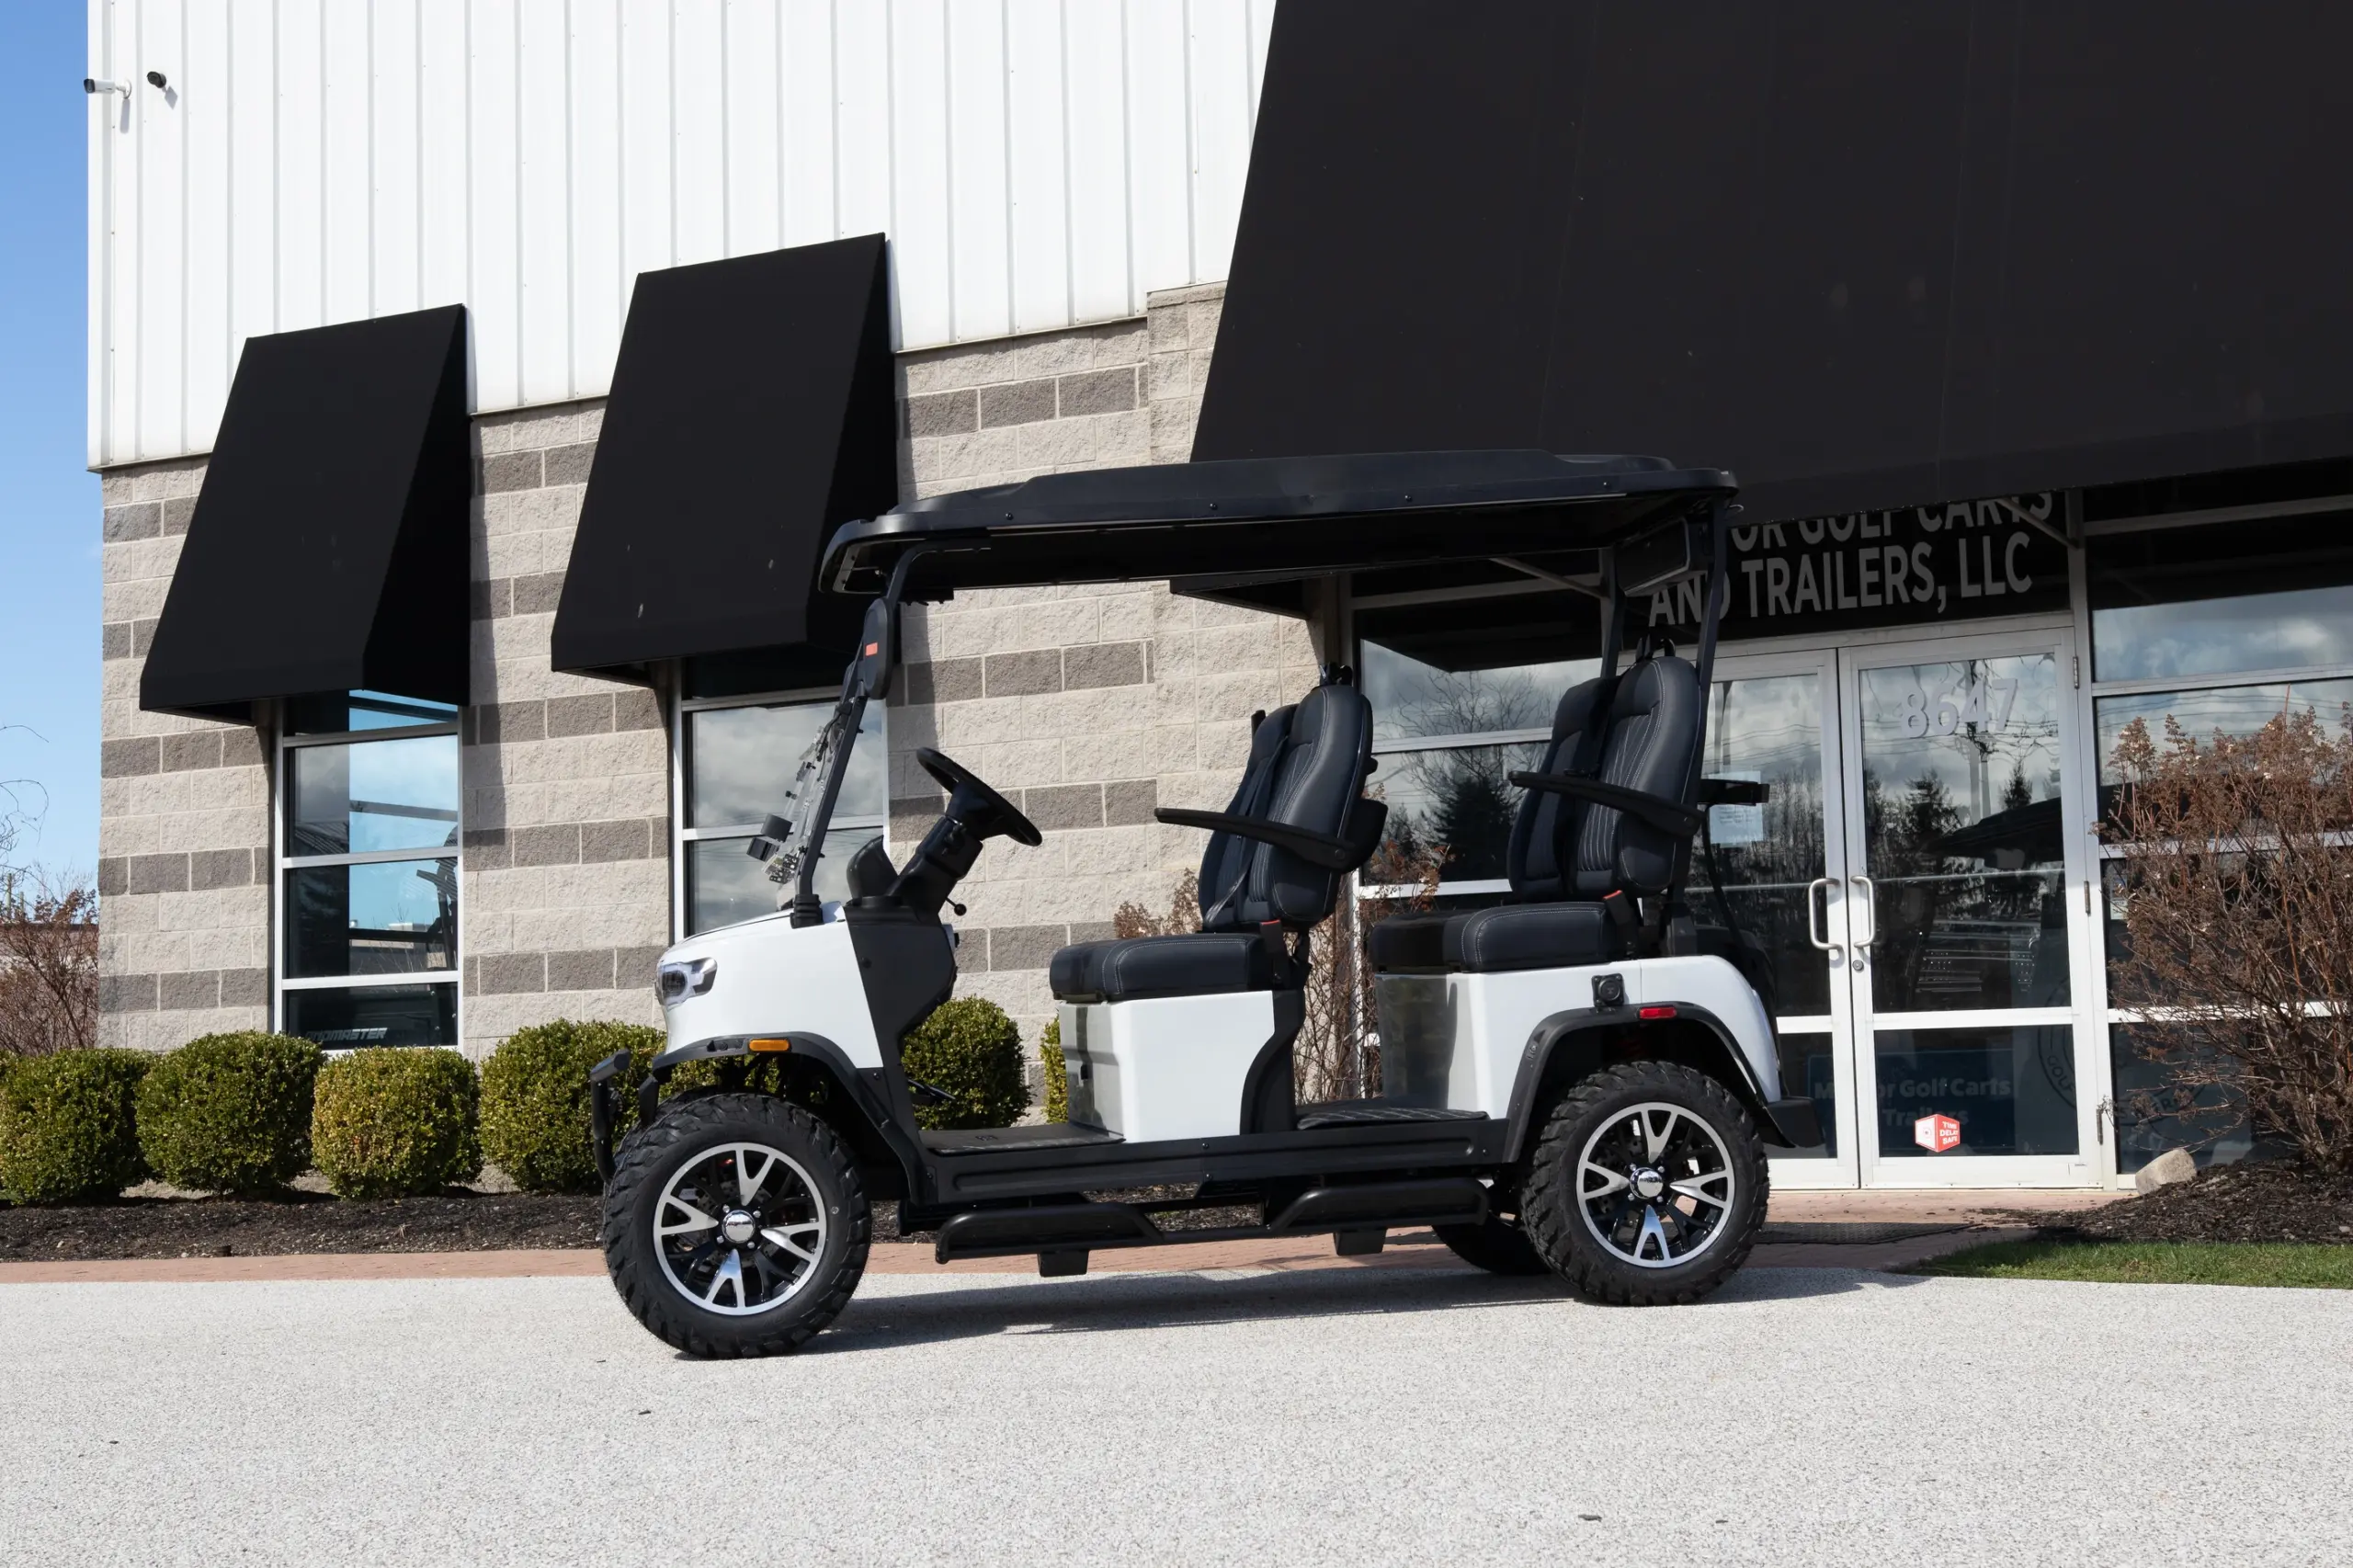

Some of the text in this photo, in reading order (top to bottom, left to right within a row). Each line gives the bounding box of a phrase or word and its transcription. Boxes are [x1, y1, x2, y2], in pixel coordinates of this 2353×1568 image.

[1741, 542, 1948, 618] TRAILERS,
[1959, 532, 2032, 598] LLC
[1901, 678, 2018, 739] 8647
[1899, 1077, 1949, 1098] Golf
[1950, 1077, 2012, 1097] Carts
